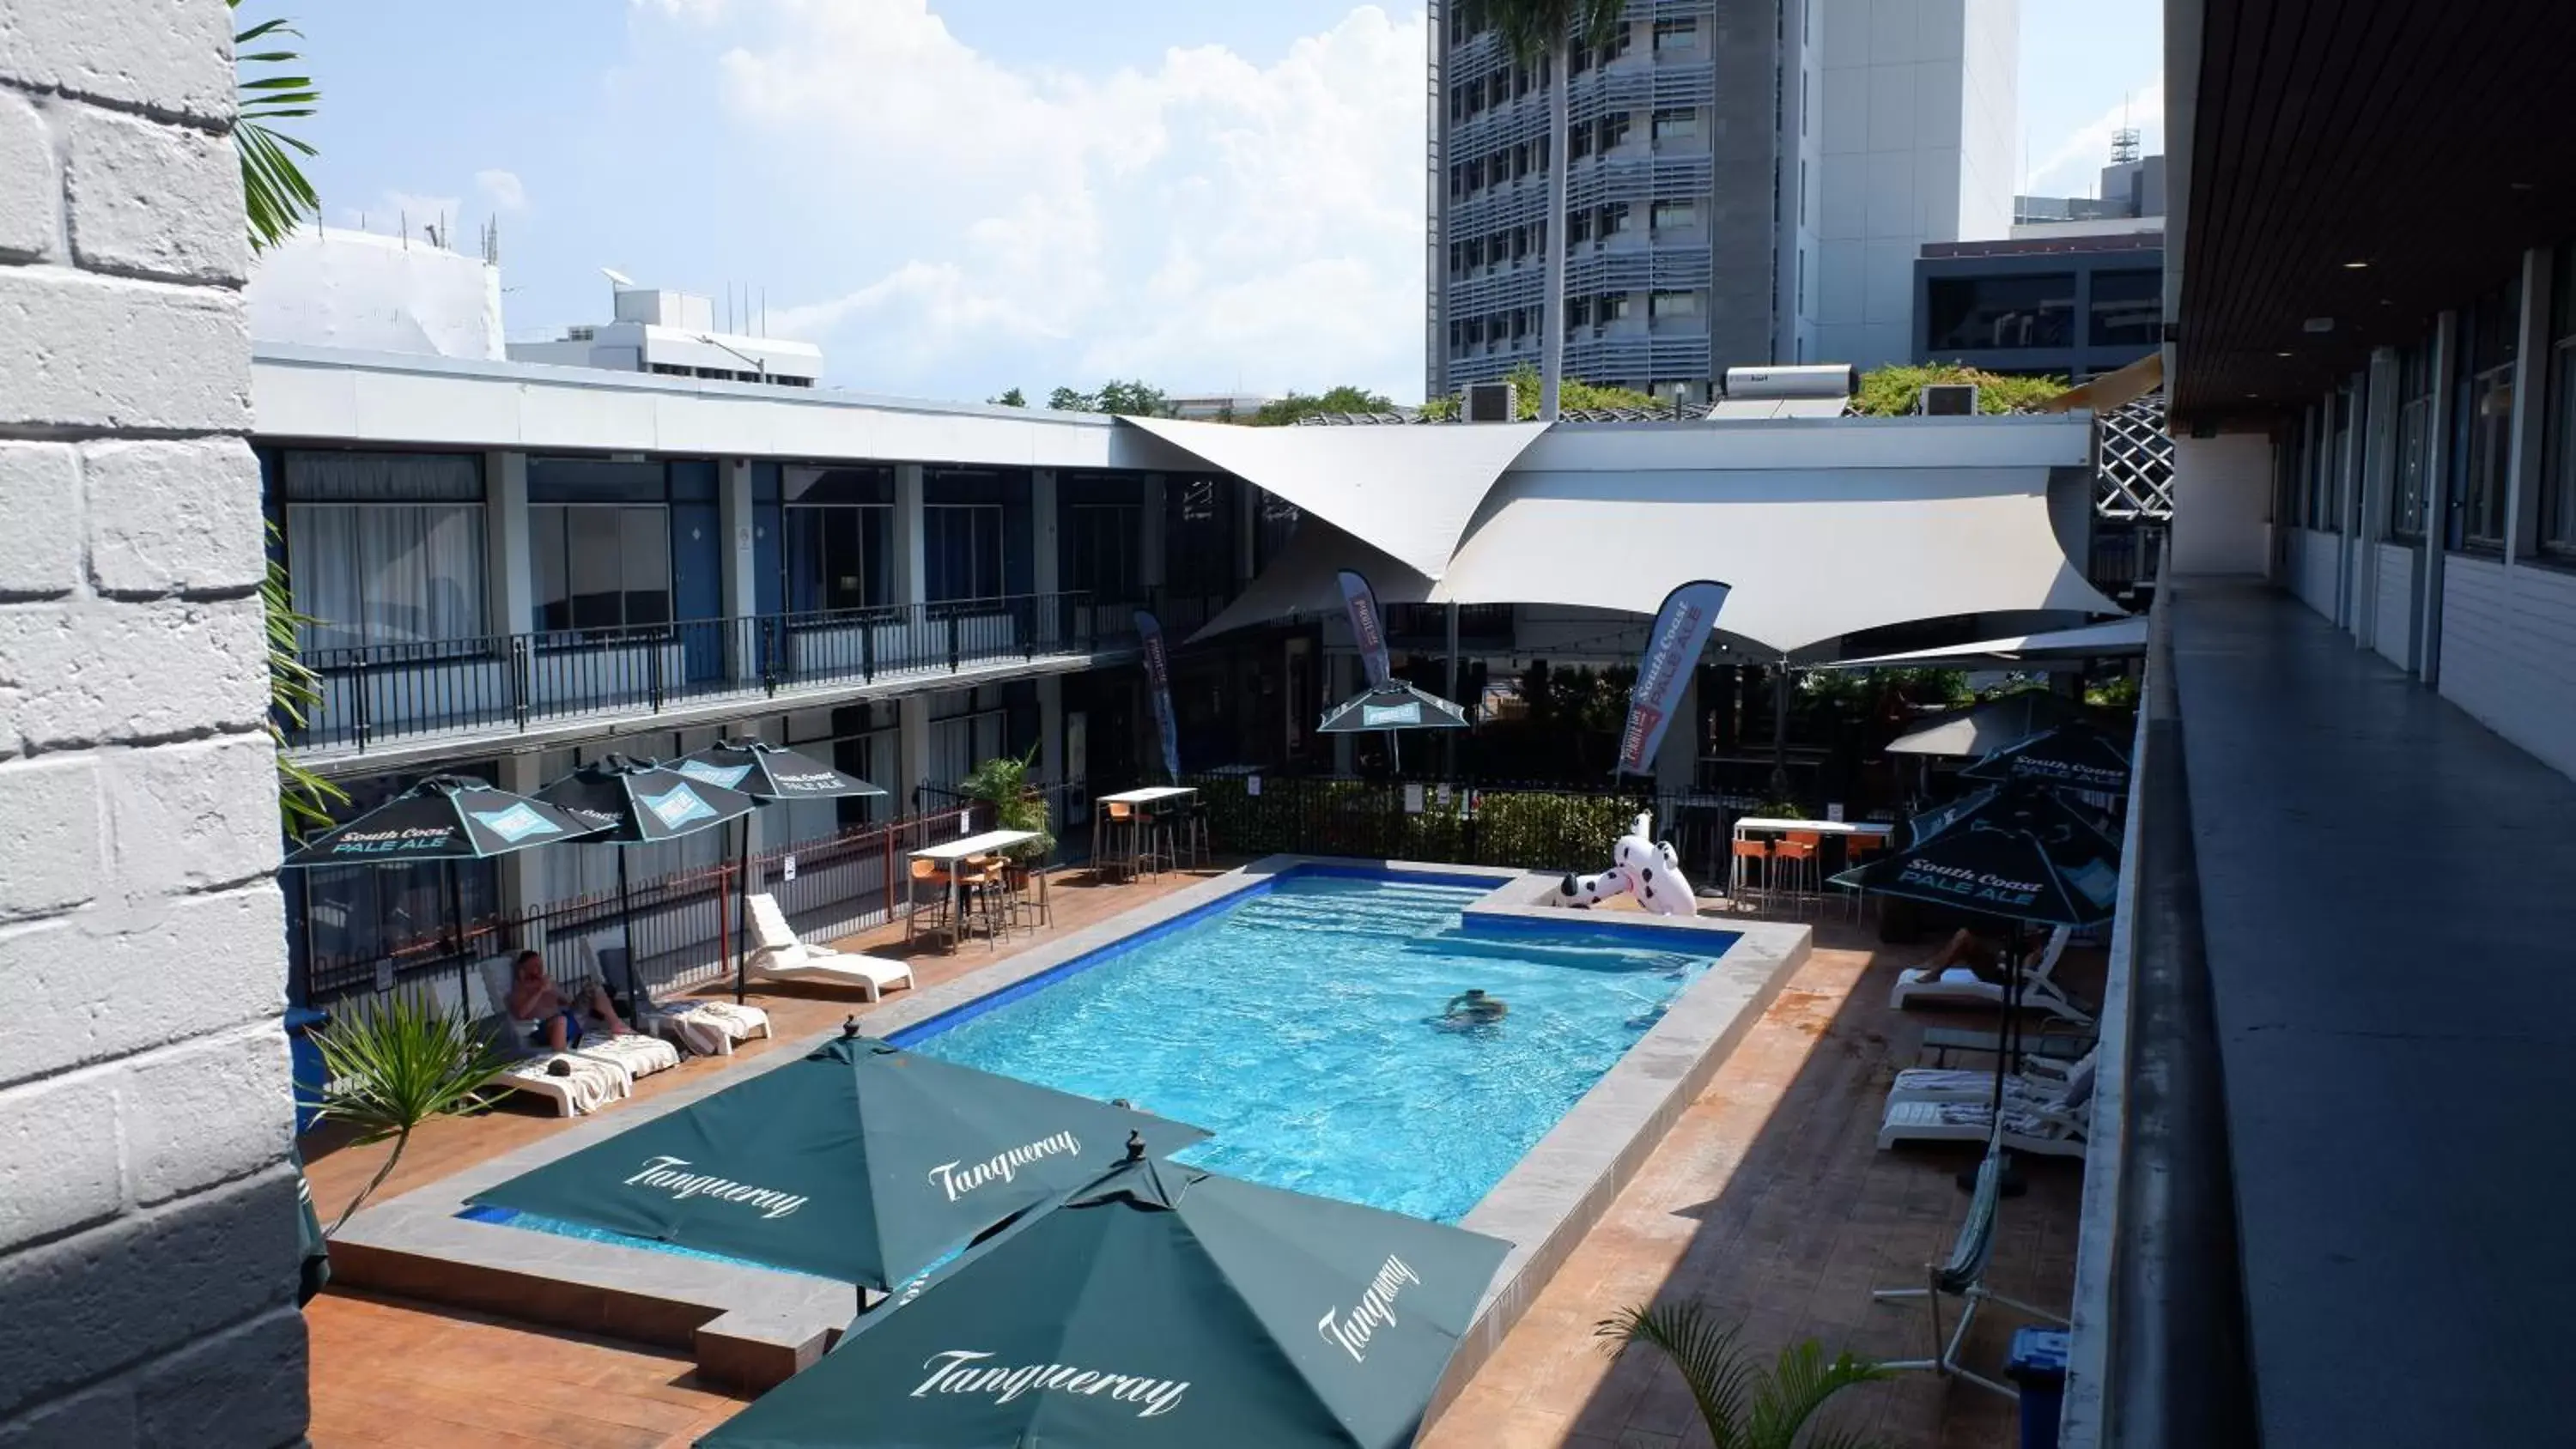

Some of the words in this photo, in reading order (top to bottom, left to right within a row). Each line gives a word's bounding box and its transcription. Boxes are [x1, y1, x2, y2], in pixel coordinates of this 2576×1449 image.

[1638, 651, 1667, 701] South
[1660, 600, 1689, 651] Coast
[1650, 651, 1682, 707] PALE
[1680, 604, 1703, 651] ALE
[331, 840, 397, 854] PALE
[398, 837, 447, 851] ALE
[340, 831, 399, 842] South
[1898, 870, 1975, 894] PALE
[1973, 888, 2037, 906] ALE
[1907, 858, 1975, 881] South
[1978, 873, 2044, 892] Coast
[624, 1155, 809, 1219] Tanqueray
[928, 1128, 1081, 1202] Tanqueray
[909, 1349, 1191, 1417] Tanqueray
